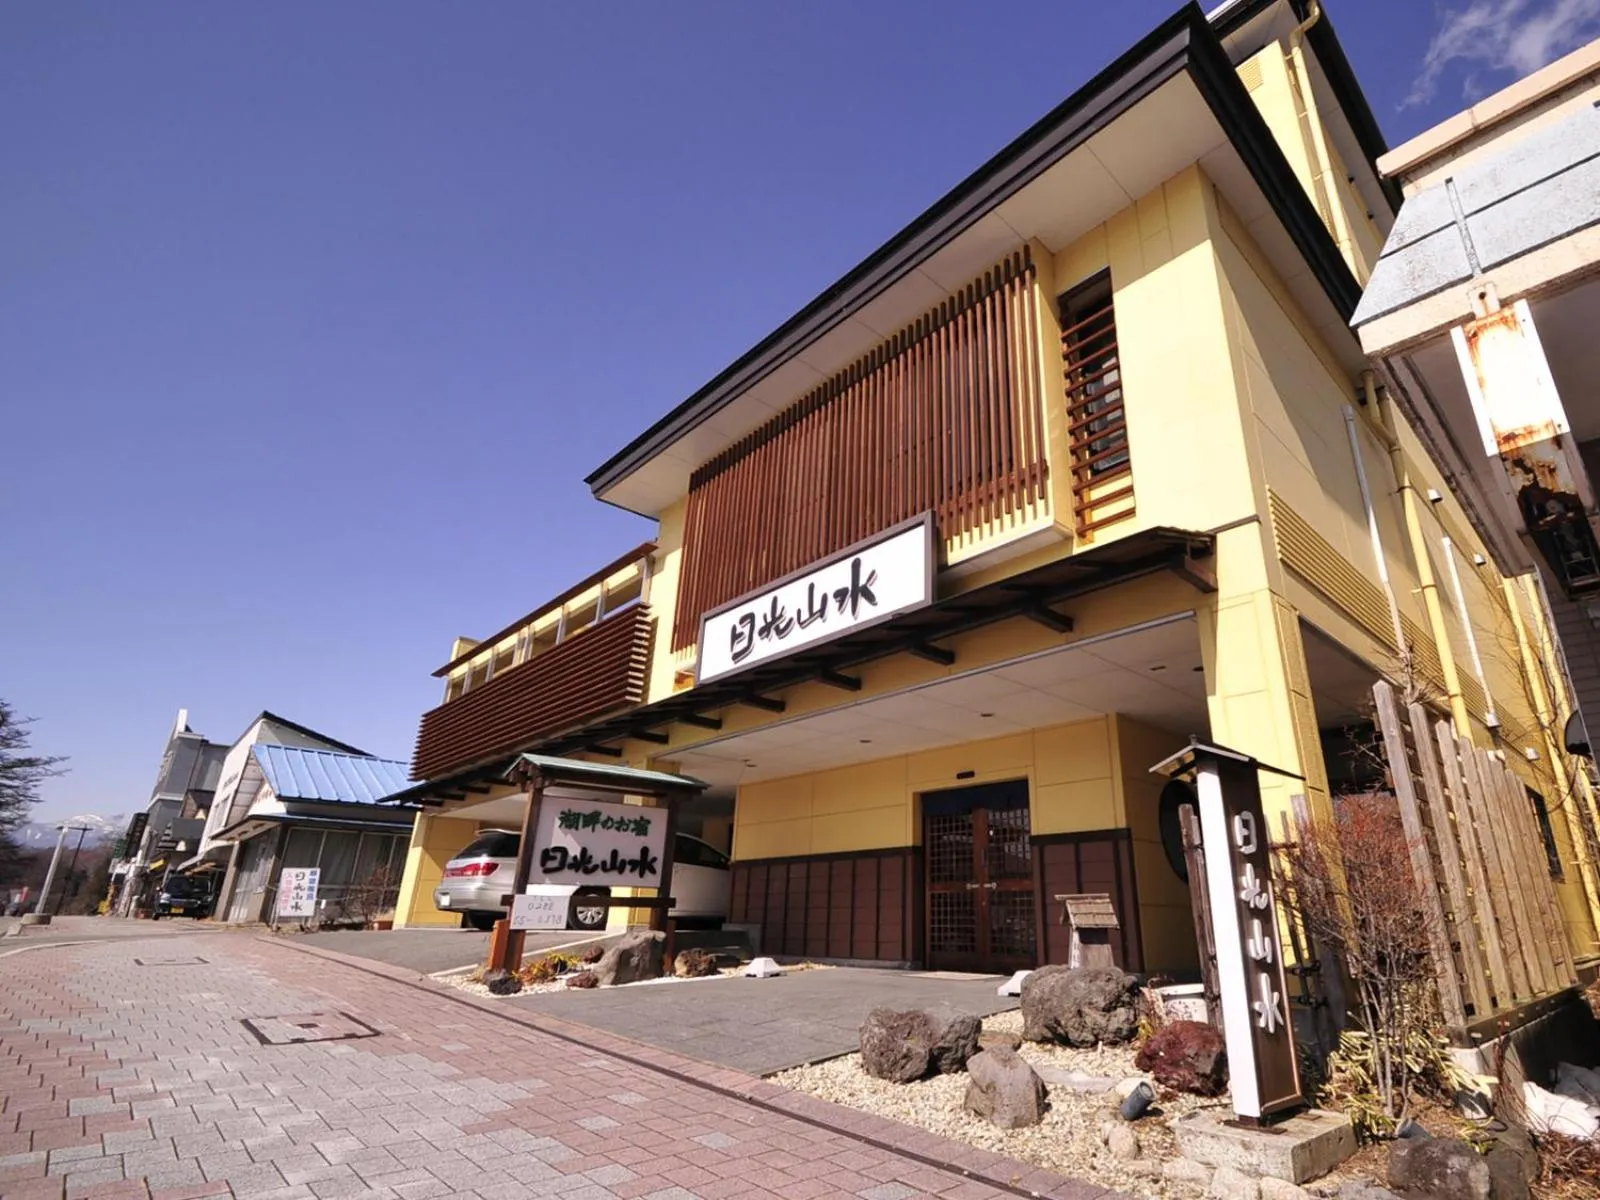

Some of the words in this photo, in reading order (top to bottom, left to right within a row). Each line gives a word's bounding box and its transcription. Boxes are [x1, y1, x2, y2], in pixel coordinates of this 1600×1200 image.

[731, 557, 878, 664] 日光山水
[540, 846, 658, 878] 日光山水
[1234, 811, 1285, 1033] 日光山水
